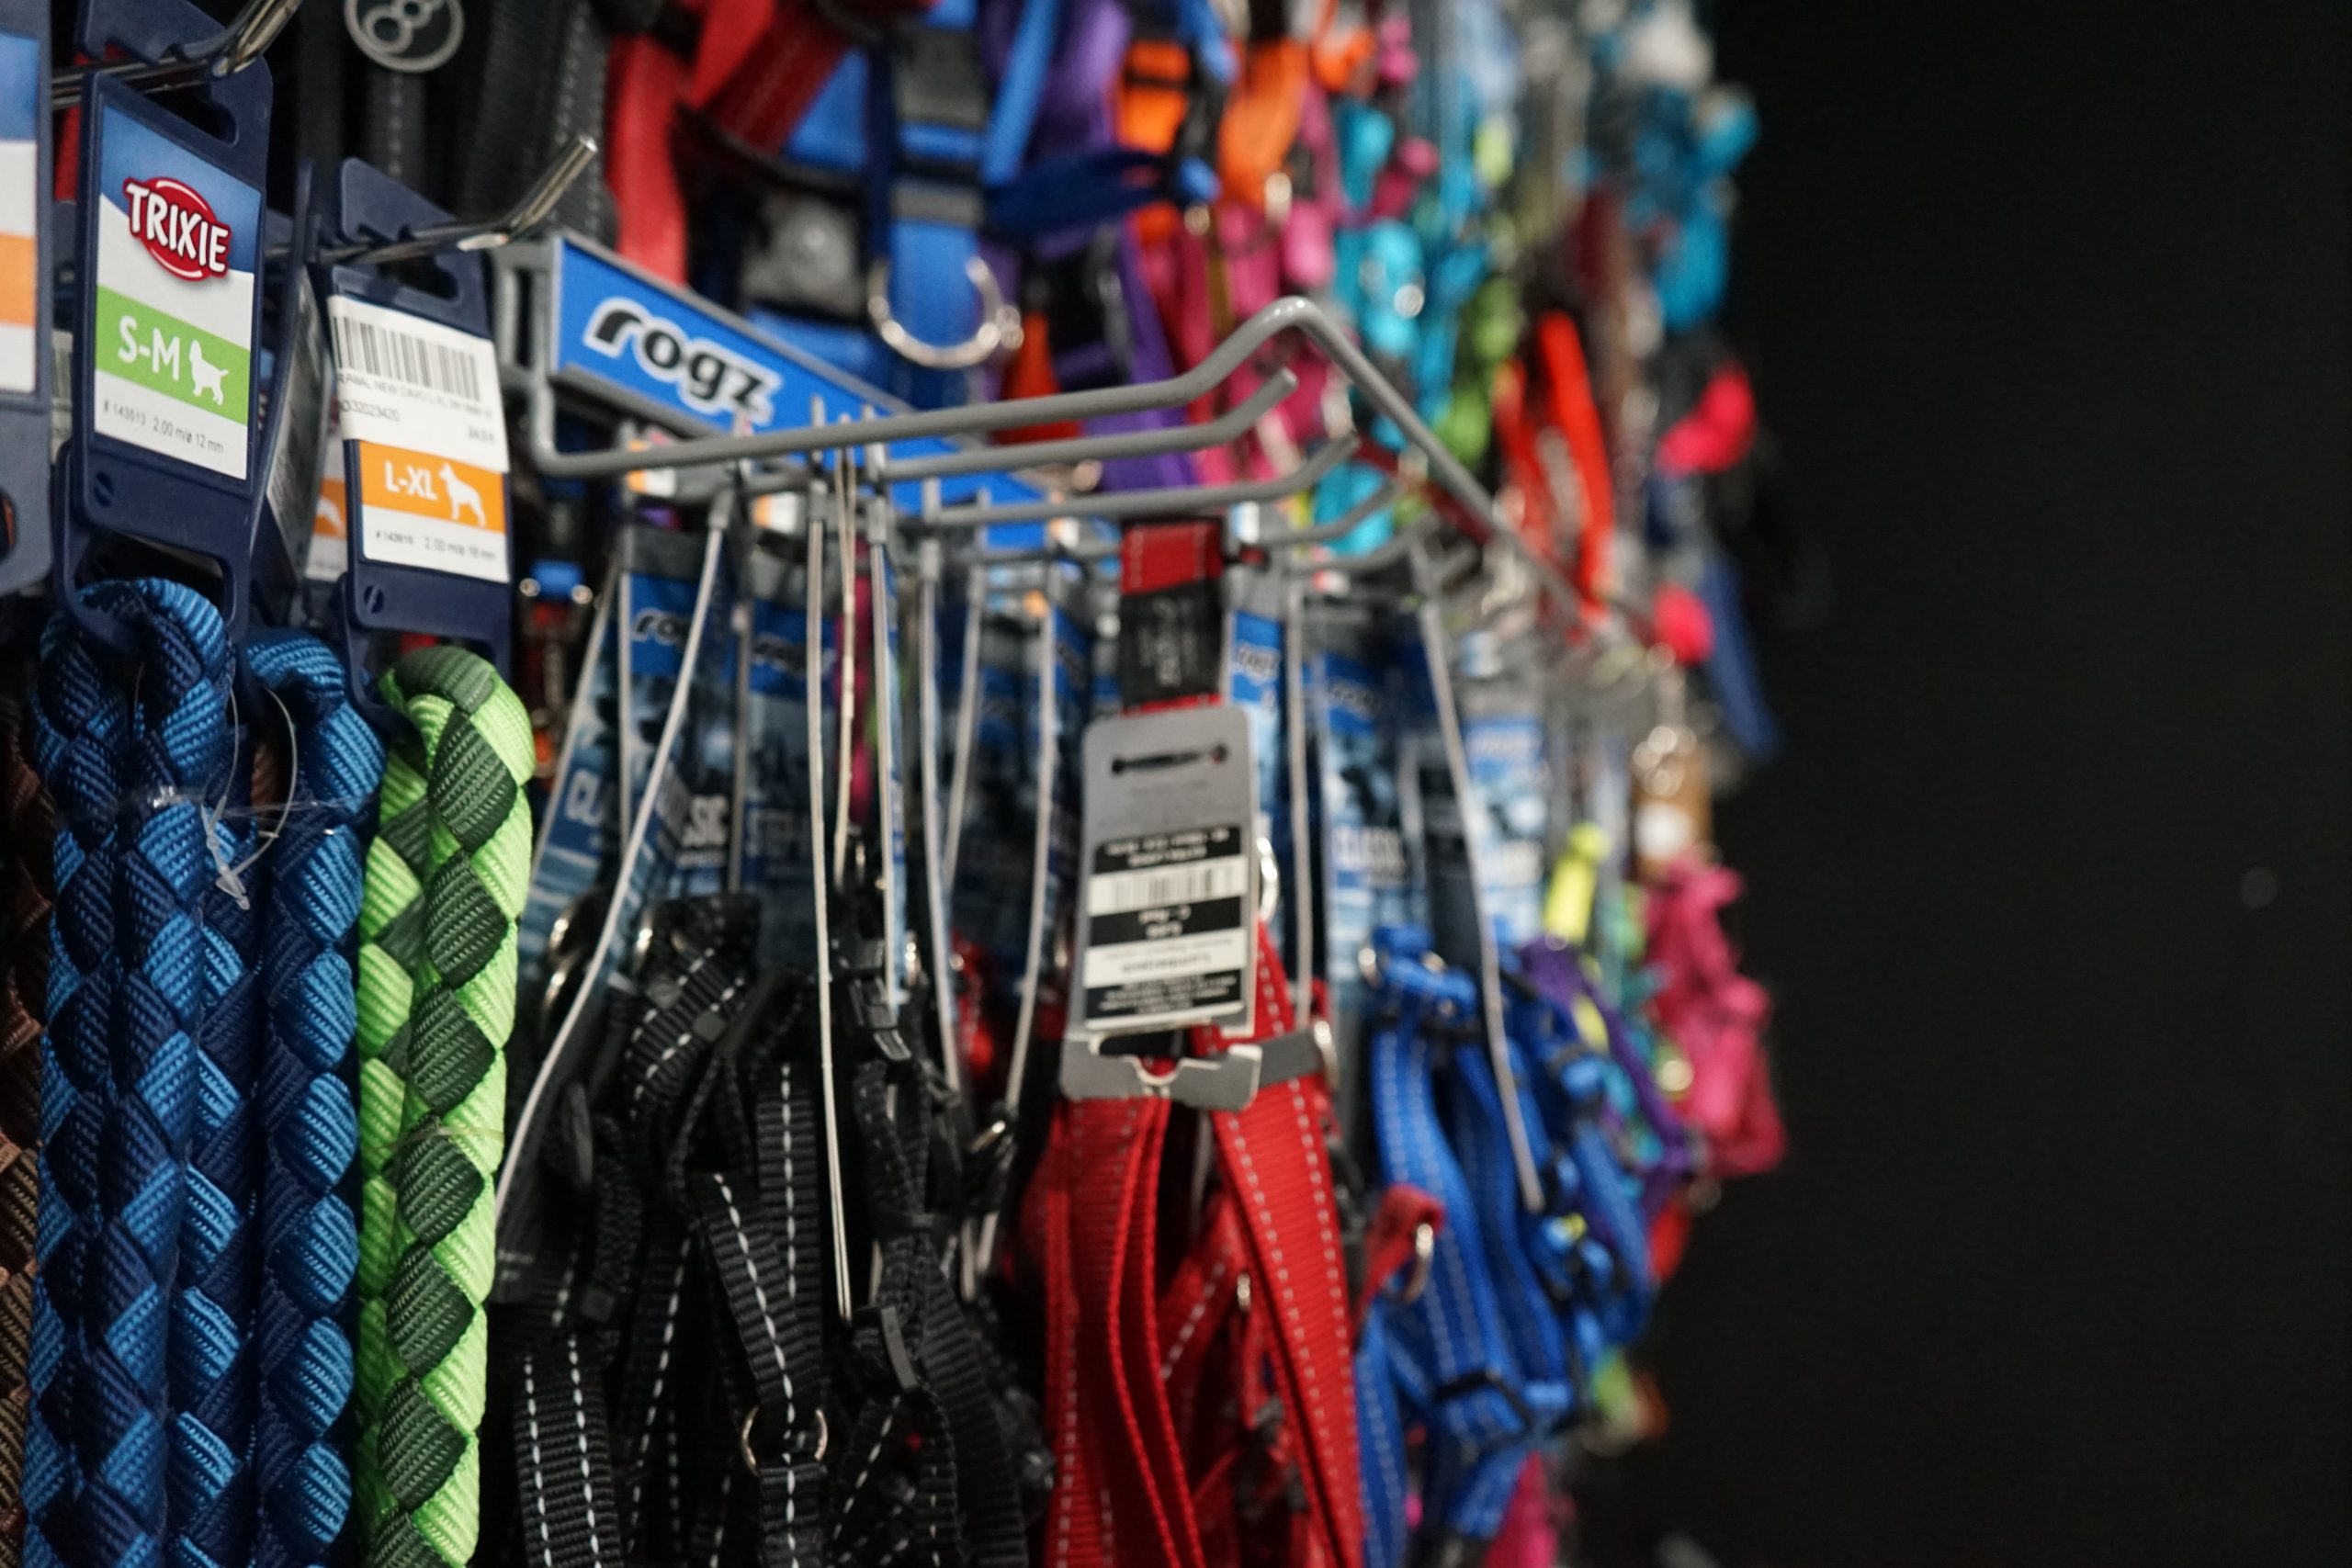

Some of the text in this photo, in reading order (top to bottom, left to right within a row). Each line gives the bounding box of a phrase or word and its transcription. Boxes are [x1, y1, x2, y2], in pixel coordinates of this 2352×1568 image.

[125, 181, 230, 274] TRIXIE
[117, 314, 182, 382] S-M
[590, 304, 775, 420] rogz
[153, 416, 175, 437] 2.00
[196, 433, 207, 449] 12
[208, 438, 224, 454] mm
[383, 459, 439, 502] L-XL
